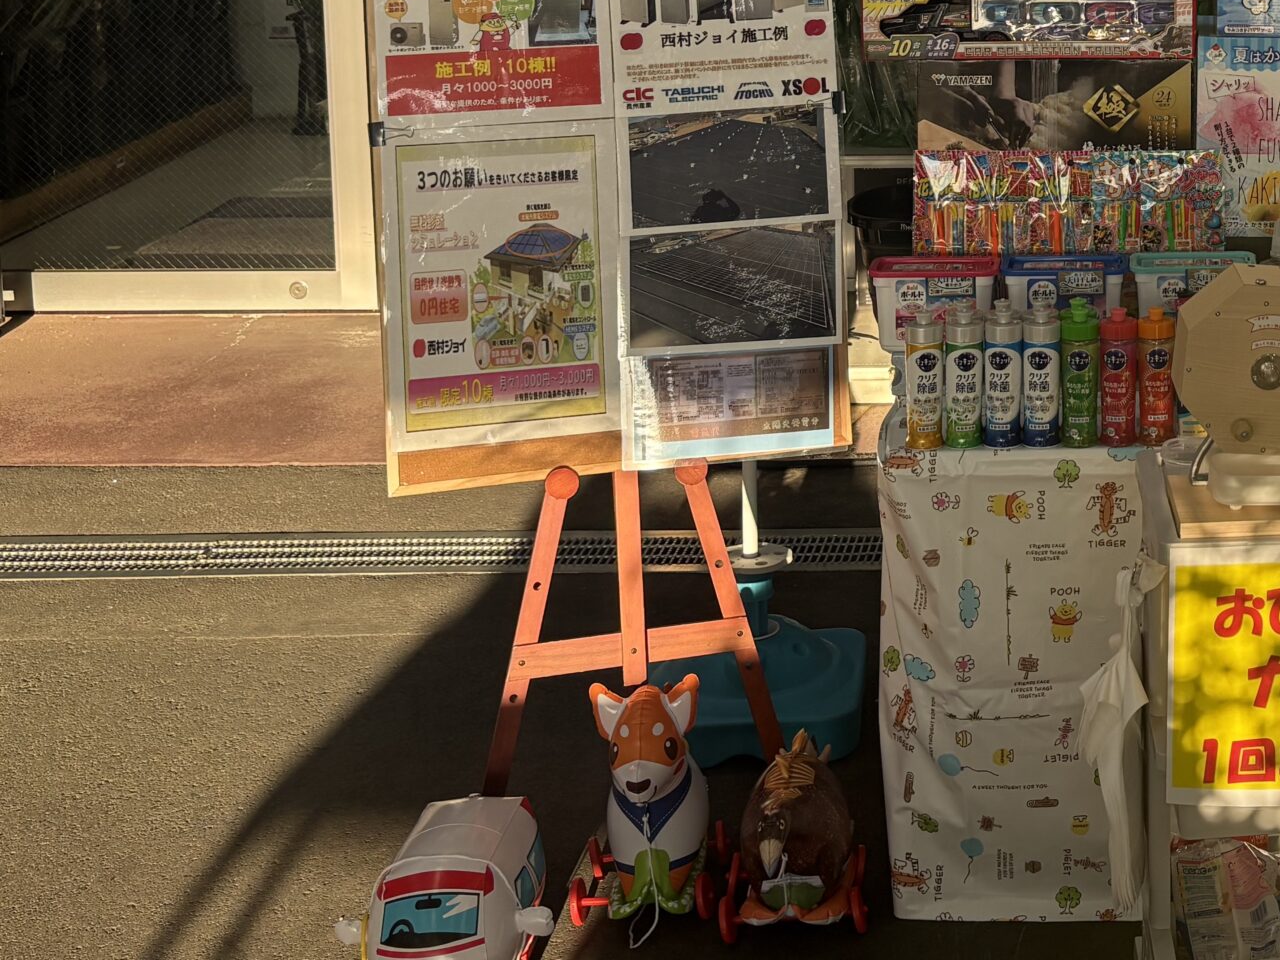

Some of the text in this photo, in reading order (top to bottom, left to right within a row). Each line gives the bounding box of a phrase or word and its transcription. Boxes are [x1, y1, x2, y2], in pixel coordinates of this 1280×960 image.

[661, 26, 788, 48] 西村ジョイ施工例
[889, 40, 911, 57] 10
[934, 39, 949, 50] 16
[964, 45, 1131, 56] CAR COLLECTION TRUCK
[435, 61, 491, 79] 施工例
[947, 75, 992, 86] YAMAZEN
[1211, 78, 1250, 92] シャリッ
[661, 85, 724, 97] TABUCHI
[734, 87, 774, 100] ITOCHU
[1156, 91, 1171, 102] 24
[669, 94, 718, 103] ELECTRIC
[901, 290, 925, 299] ボールド
[1031, 289, 1056, 299] ボールド
[420, 297, 460, 315] 0円住宅
[427, 338, 467, 356] 西村ジョイ
[917, 383, 937, 394] 除菌
[956, 383, 976, 394] 除菌
[990, 381, 1010, 392] 除菌
[1029, 381, 1050, 392] 除菌
[928, 449, 938, 483] TIGGE
[1037, 490, 1046, 520] POOH
[1088, 539, 1126, 548] TIGGER
[1050, 587, 1080, 596] POOH
[893, 733, 915, 753] TIGGER
[1043, 752, 1079, 762] PIGLET
[1063, 849, 1072, 876] PIGLET
[935, 864, 944, 902] TIGGER
